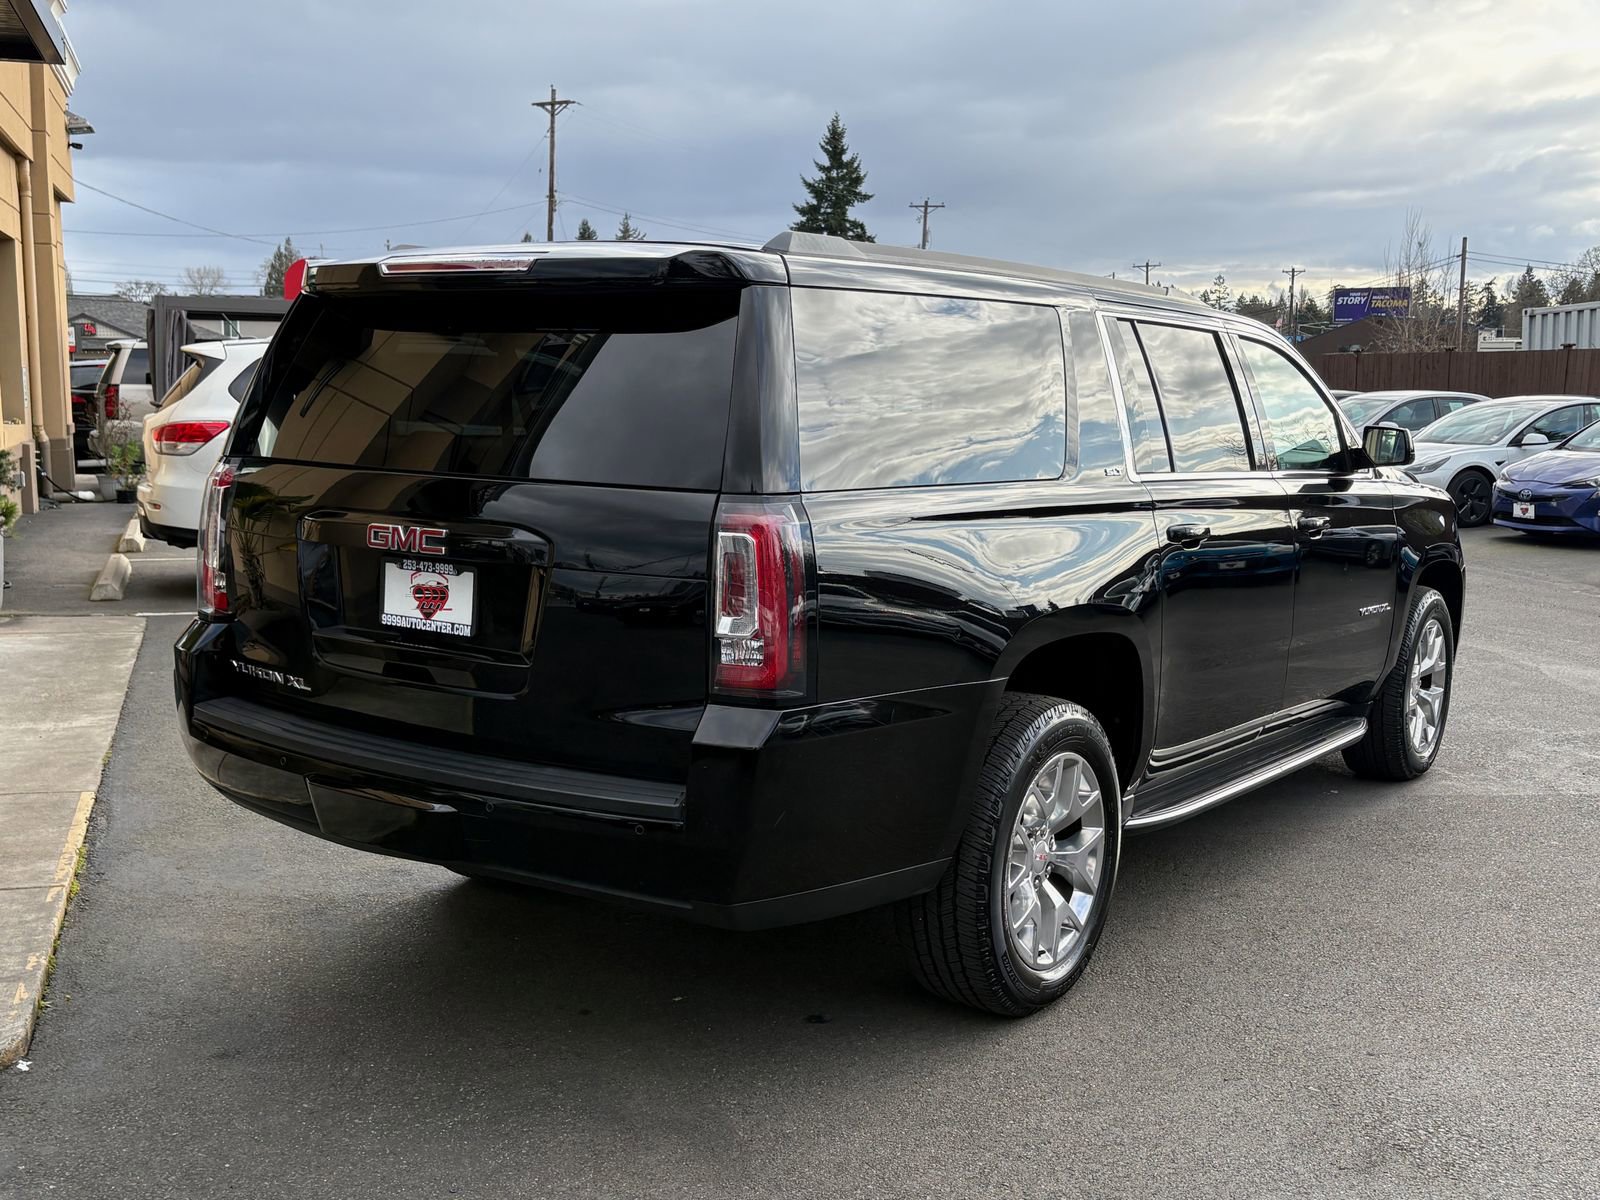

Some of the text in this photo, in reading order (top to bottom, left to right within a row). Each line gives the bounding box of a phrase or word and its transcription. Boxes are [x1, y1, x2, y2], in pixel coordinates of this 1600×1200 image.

[1336, 296, 1368, 305] STORY
[1371, 299, 1408, 308] TACOMA
[367, 523, 448, 555] GMC
[402, 560, 454, 575] 253-473-9999
[381, 613, 471, 637] 9999AUTOCENTER.COM
